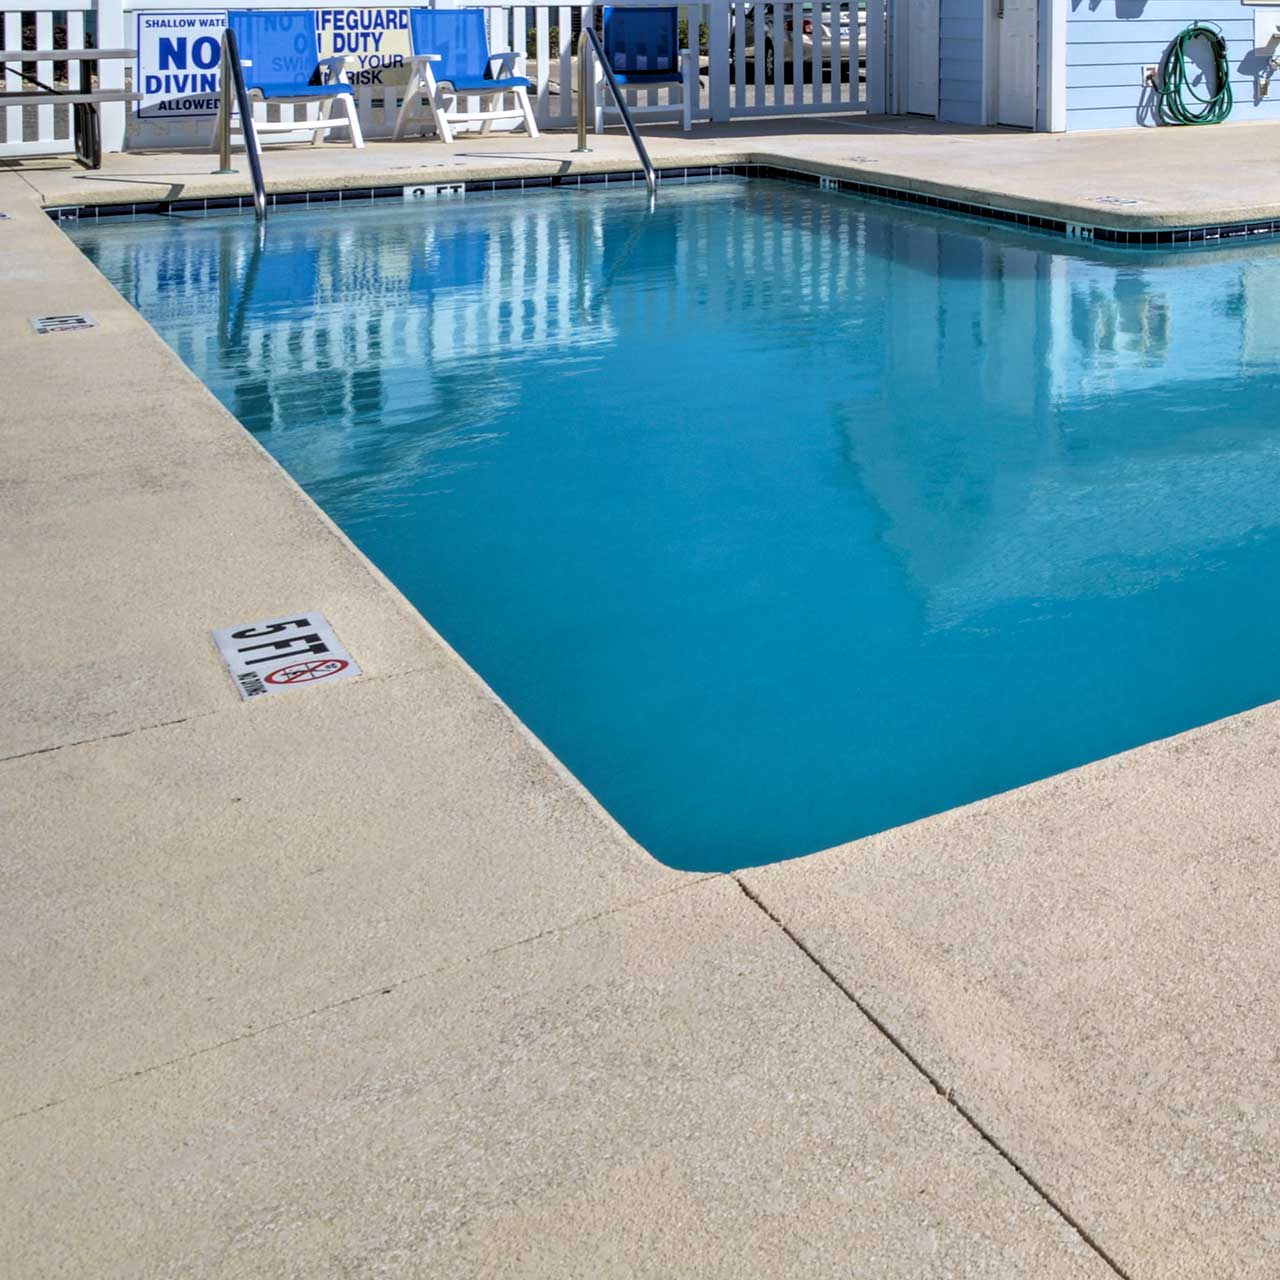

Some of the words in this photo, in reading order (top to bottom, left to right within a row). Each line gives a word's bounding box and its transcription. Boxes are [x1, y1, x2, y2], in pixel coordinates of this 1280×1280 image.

[145, 19, 196, 28] SHALLOW
[198, 19, 226, 27] WATE
[305, 10, 408, 30] IFEGUARD
[158, 36, 221, 70] NO
[333, 32, 383, 53] DUTY
[358, 55, 404, 69] YOUR
[145, 73, 221, 94] DIVIN
[158, 99, 221, 111] ALLOWED
[231, 617, 312, 639] 5
[237, 632, 330, 666] FT
